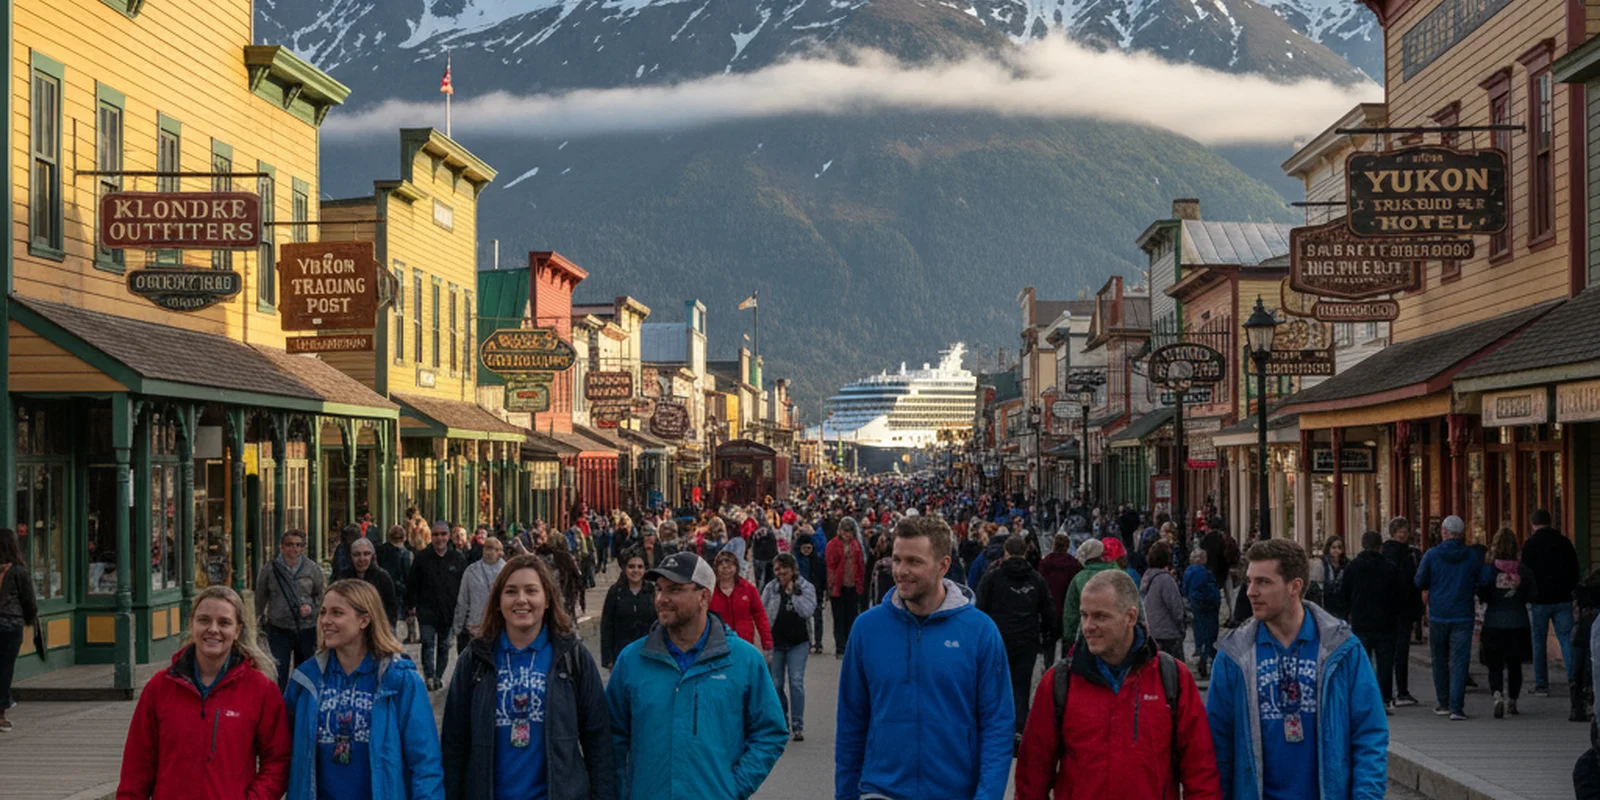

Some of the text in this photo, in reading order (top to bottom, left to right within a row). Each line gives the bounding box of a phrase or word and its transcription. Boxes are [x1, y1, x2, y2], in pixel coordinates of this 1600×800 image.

[1364, 168, 1489, 193] YUKON
[113, 199, 248, 219] KLONDKE
[109, 222, 254, 241] OUTFITERS
[1375, 214, 1473, 231] HOTEL
[291, 277, 366, 295] TRADING
[306, 297, 352, 314] POST
